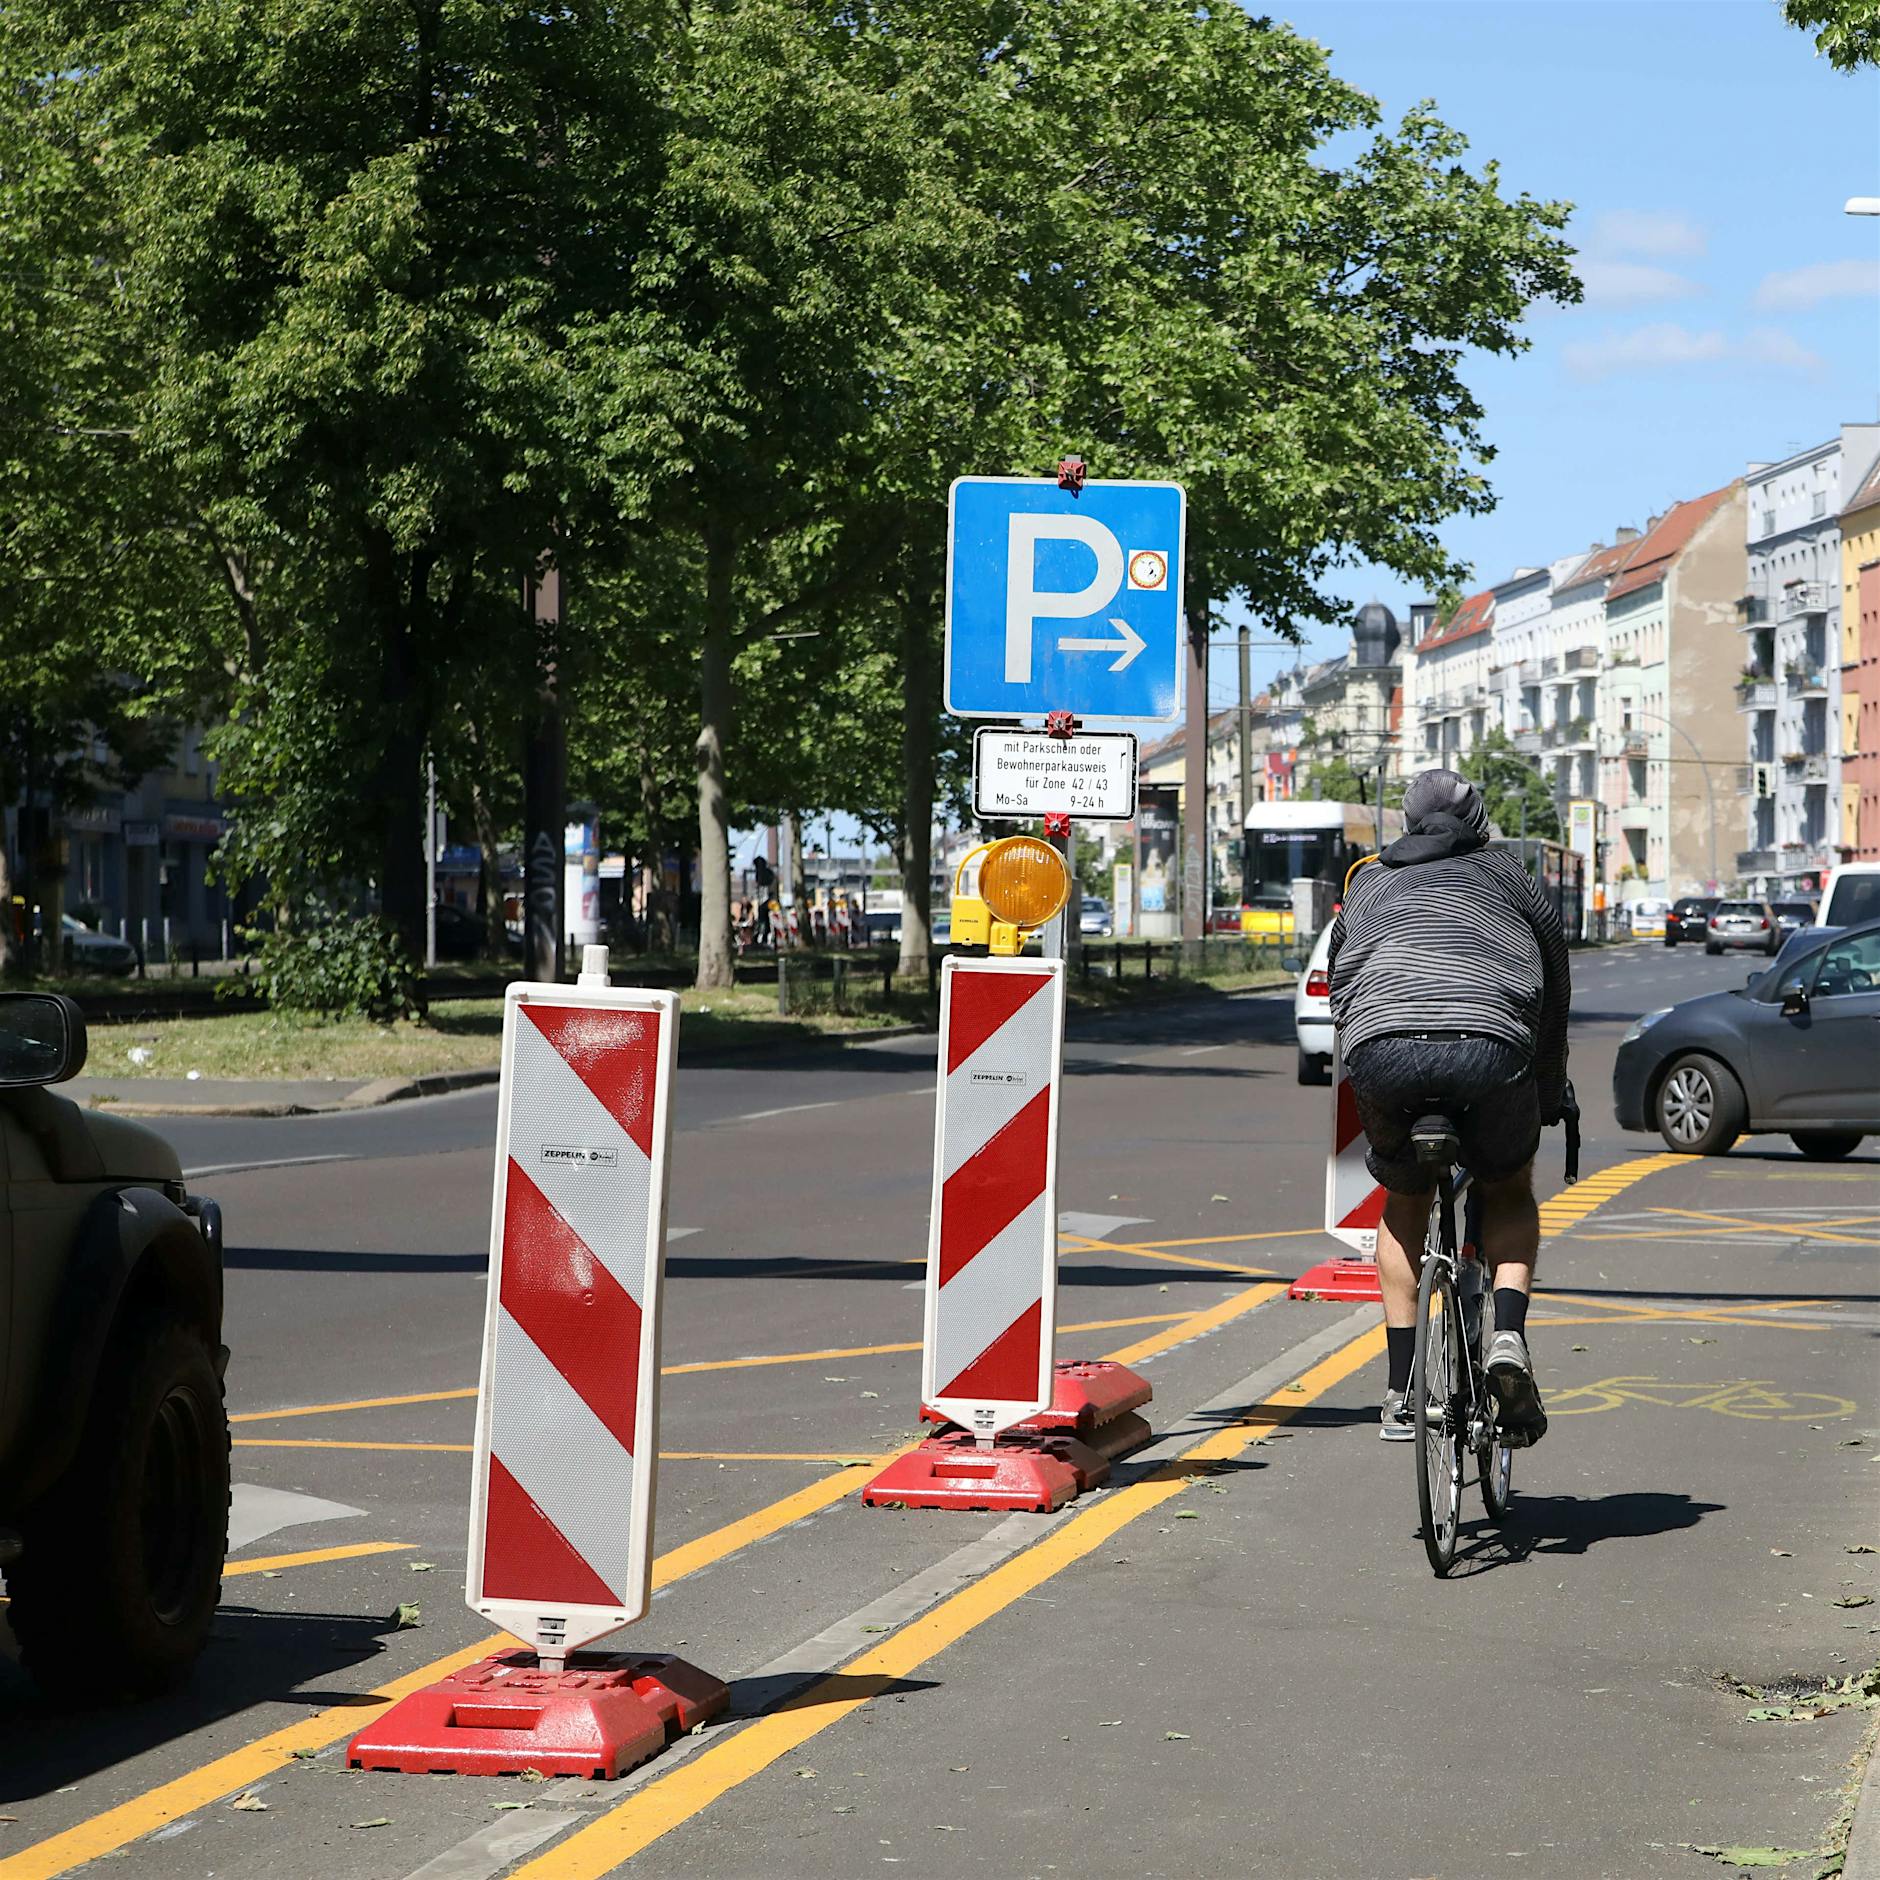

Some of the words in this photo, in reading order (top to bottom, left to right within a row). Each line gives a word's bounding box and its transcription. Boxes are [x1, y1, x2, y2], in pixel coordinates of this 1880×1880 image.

[1004, 512, 1125, 683] P
[1004, 741, 1020, 753] mit
[1023, 741, 1077, 755] Parkschein
[1080, 743, 1102, 755] oder
[997, 758, 1107, 773] Bewohnerparkausweis
[1025, 776, 1039, 789] für
[1043, 777, 1066, 789] Zone
[1072, 778, 1084, 790] 42
[1096, 779, 1108, 791] 43
[996, 793, 1028, 806] Mo-Sa
[1070, 795, 1095, 808] 9-24
[1098, 796, 1104, 808] h
[544, 1150, 586, 1160] ZEPPELIN
